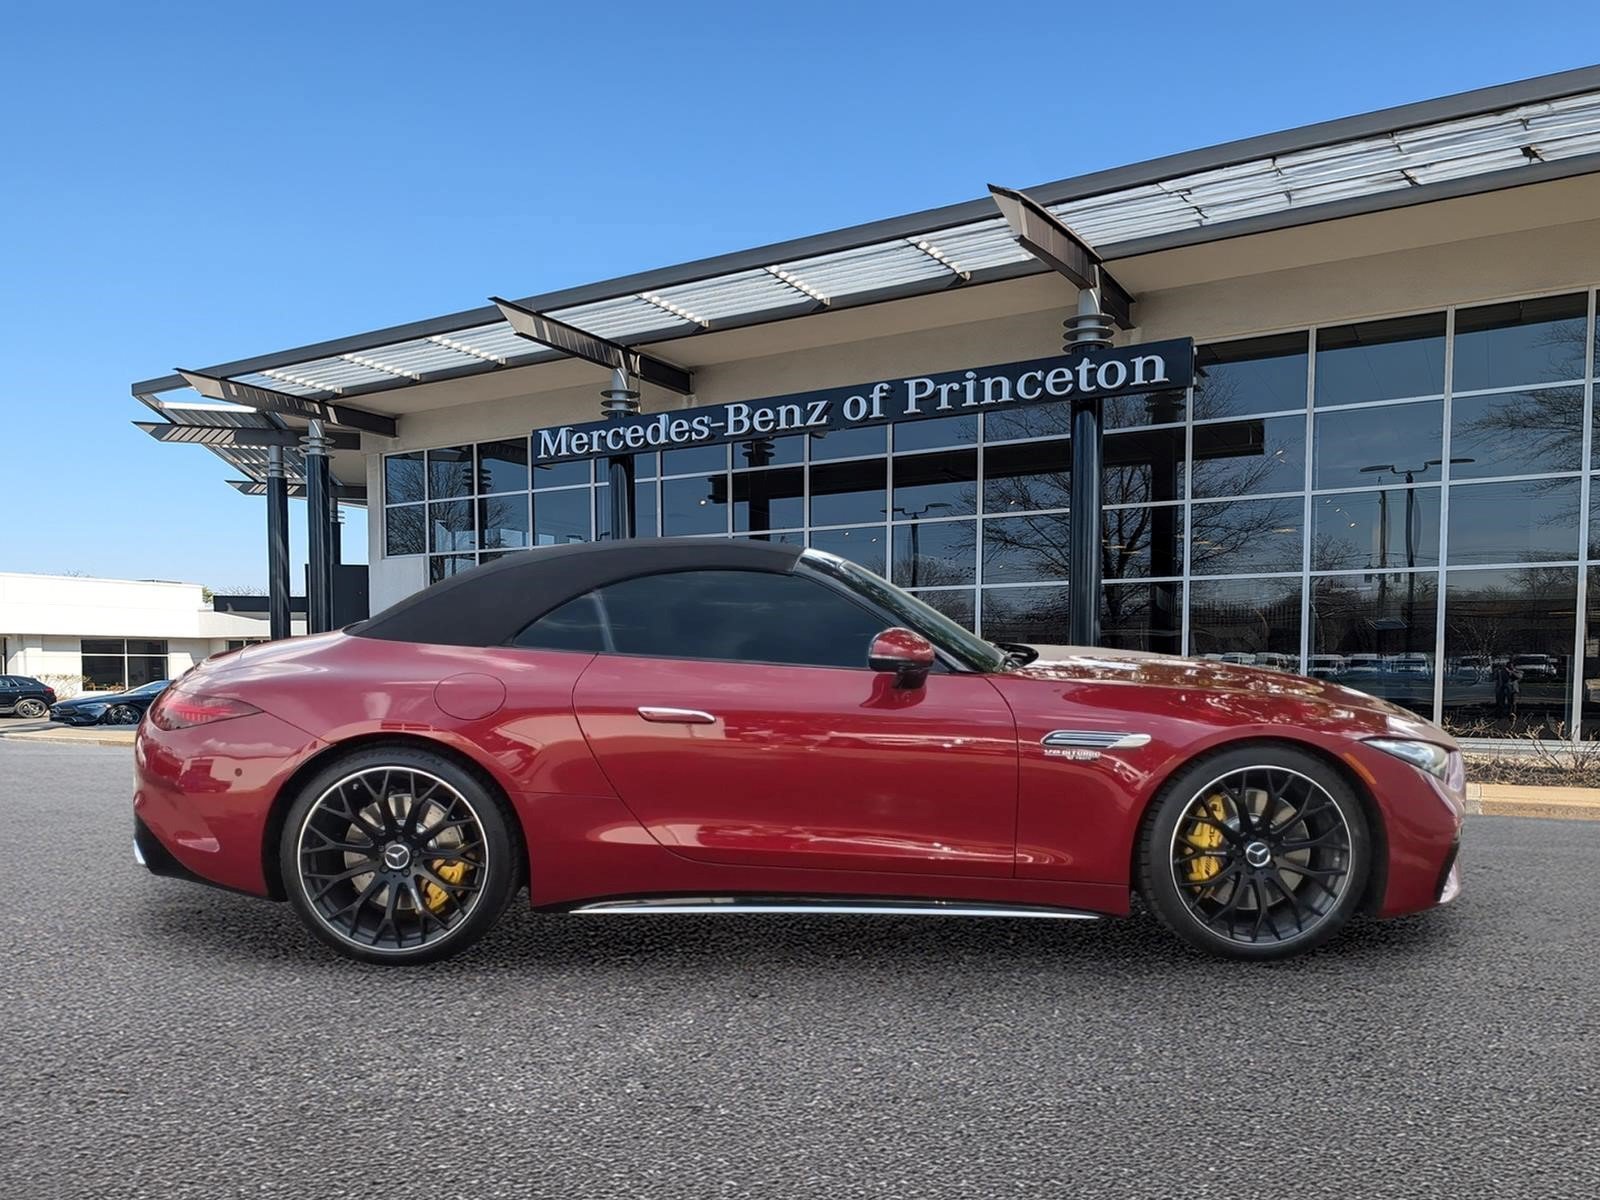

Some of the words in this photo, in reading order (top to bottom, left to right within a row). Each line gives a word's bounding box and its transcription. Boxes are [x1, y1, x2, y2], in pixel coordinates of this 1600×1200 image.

[537, 399, 828, 459] Mercedes-Benz
[842, 382, 892, 422] of
[903, 353, 1170, 415] Princeton
